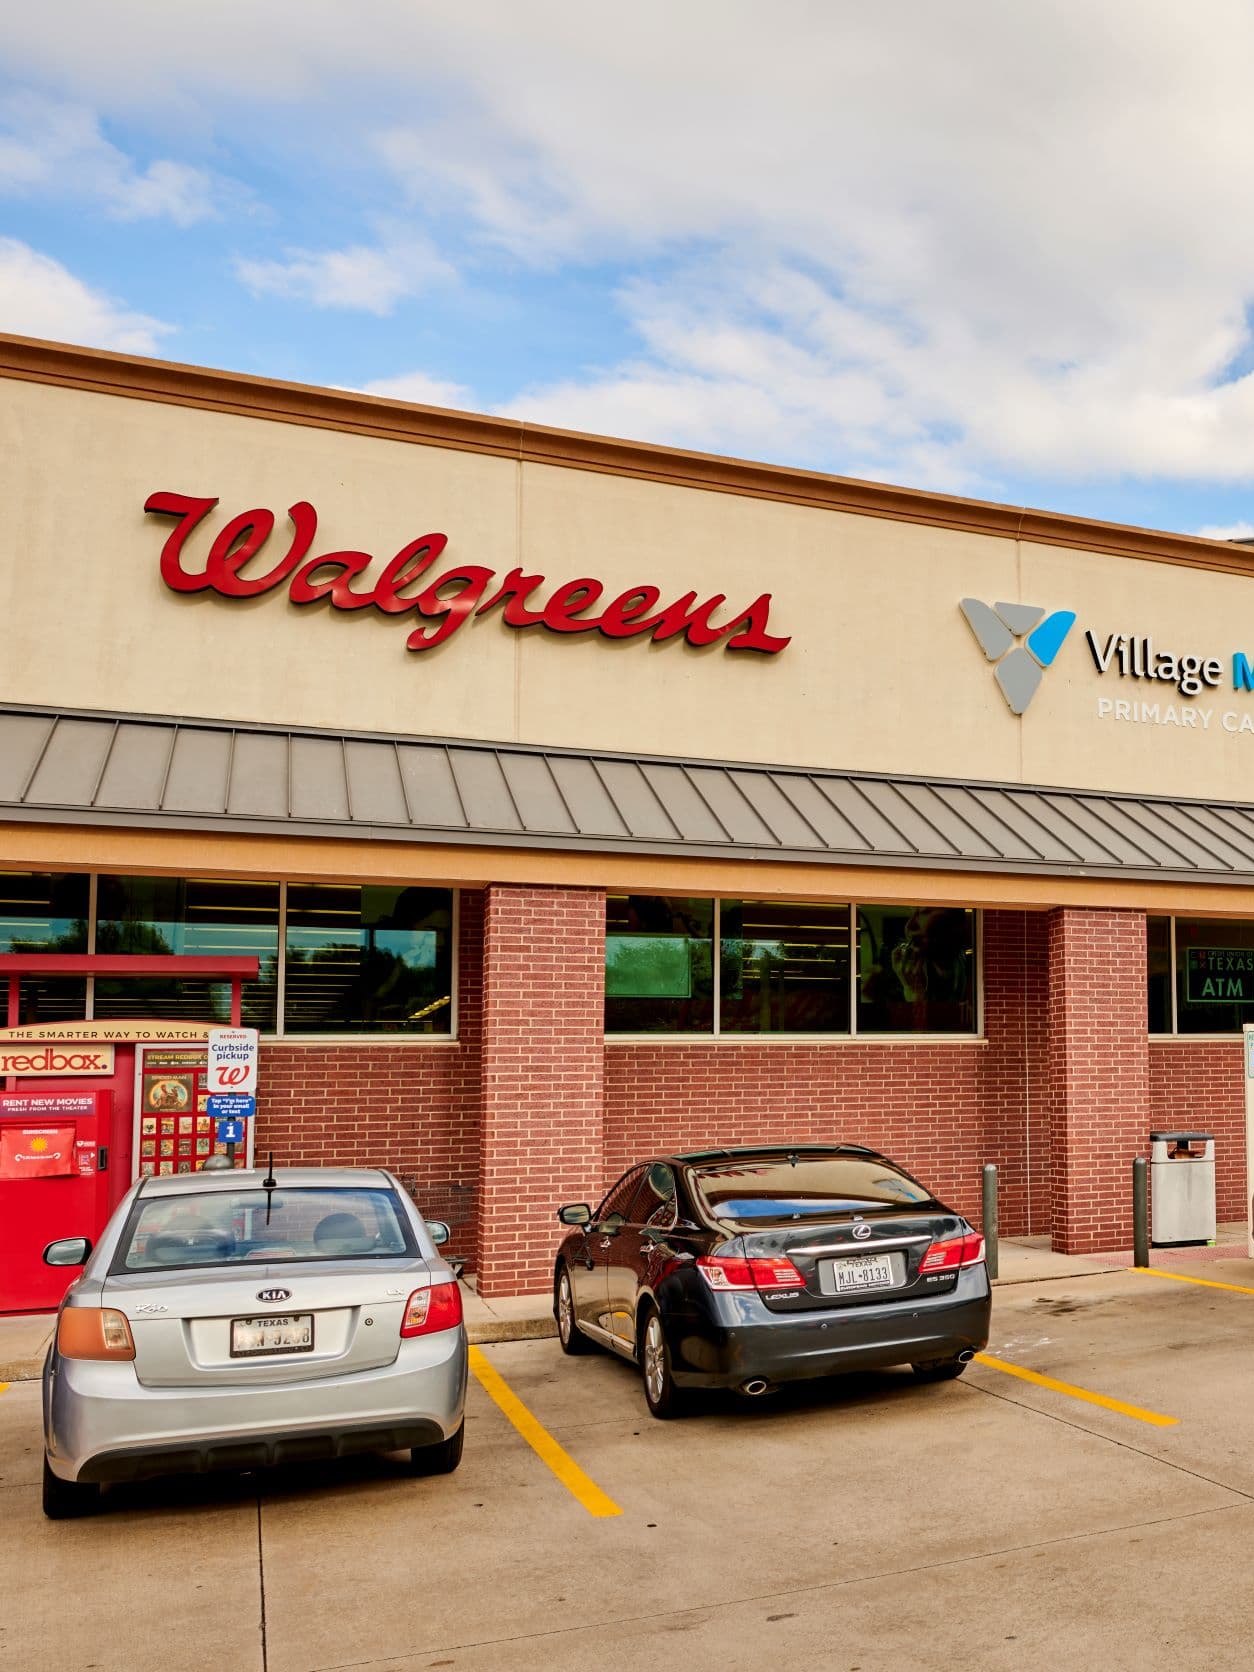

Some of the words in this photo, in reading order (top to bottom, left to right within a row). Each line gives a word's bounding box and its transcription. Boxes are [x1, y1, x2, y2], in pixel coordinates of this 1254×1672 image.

[144, 491, 793, 653] Walgreens
[1085, 629, 1224, 697] Village
[1097, 697, 1214, 729] PRIMARY
[1207, 957, 1254, 971] TEXAS
[1201, 977, 1243, 997] ATM
[211, 1043, 255, 1052] Curbside
[216, 1051, 250, 1061] pickup
[2, 1099, 29, 1107] RENT
[31, 1098, 55, 1106] NEW
[56, 1097, 93, 1105] MOVIES
[851, 1260, 873, 1268] TEXAS
[262, 1290, 287, 1300] KIA
[764, 1292, 800, 1301] LEXUS
[257, 1318, 289, 1328] TEXAS
